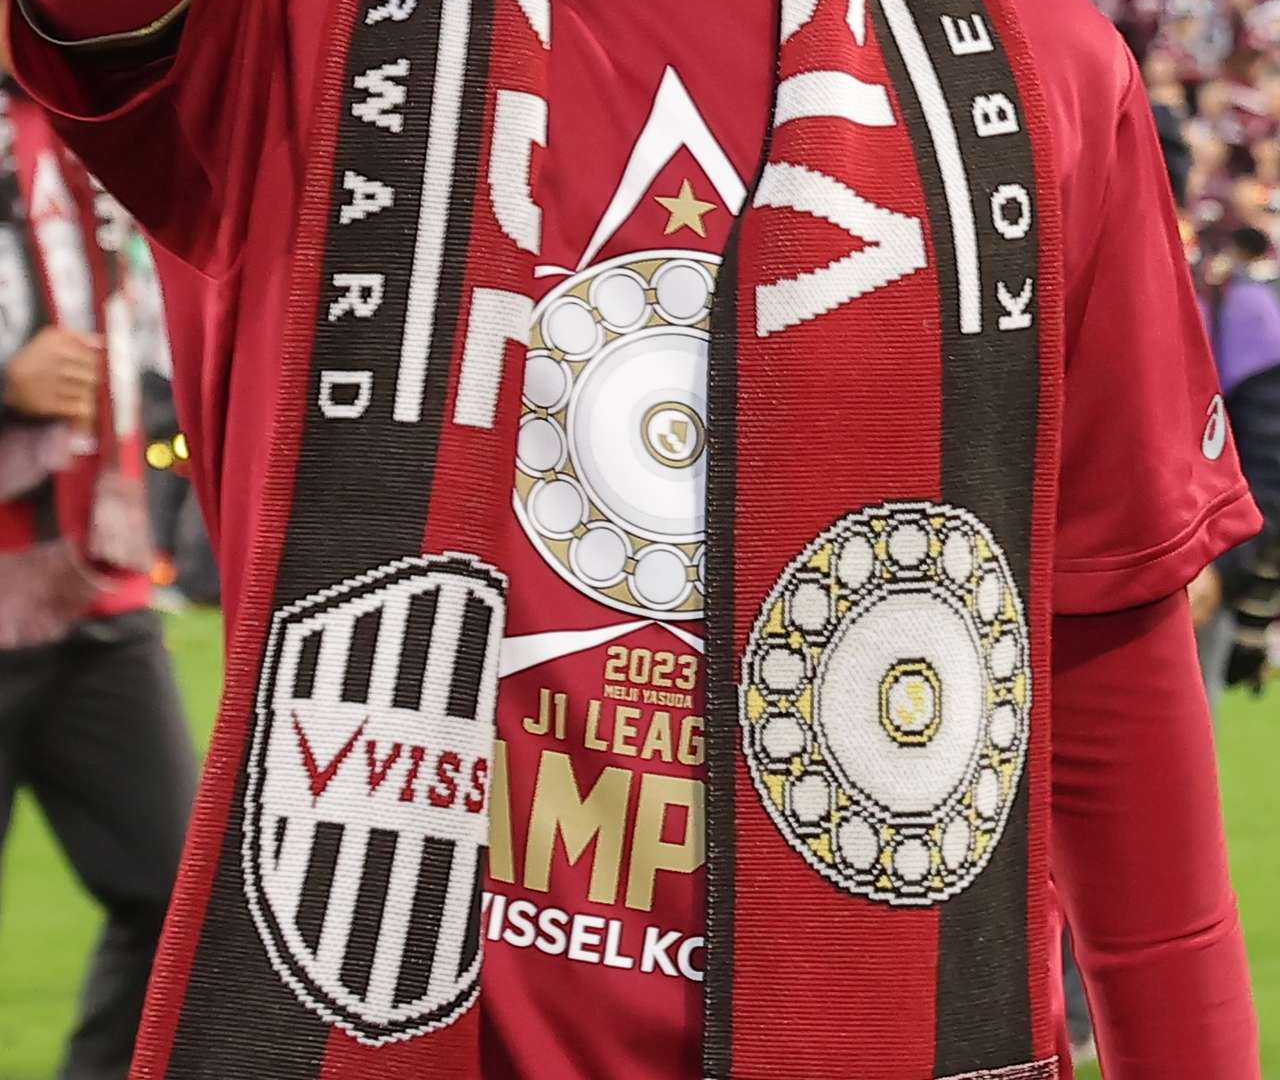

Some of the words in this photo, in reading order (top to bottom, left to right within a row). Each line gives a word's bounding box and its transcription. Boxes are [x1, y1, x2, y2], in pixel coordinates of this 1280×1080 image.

[940, 12, 1034, 332] KOBE
[604, 645, 699, 690] 2023
[522, 687, 568, 740] J1
[603, 683, 640, 704] MEIJI
[642, 688, 694, 709] YASUDA
